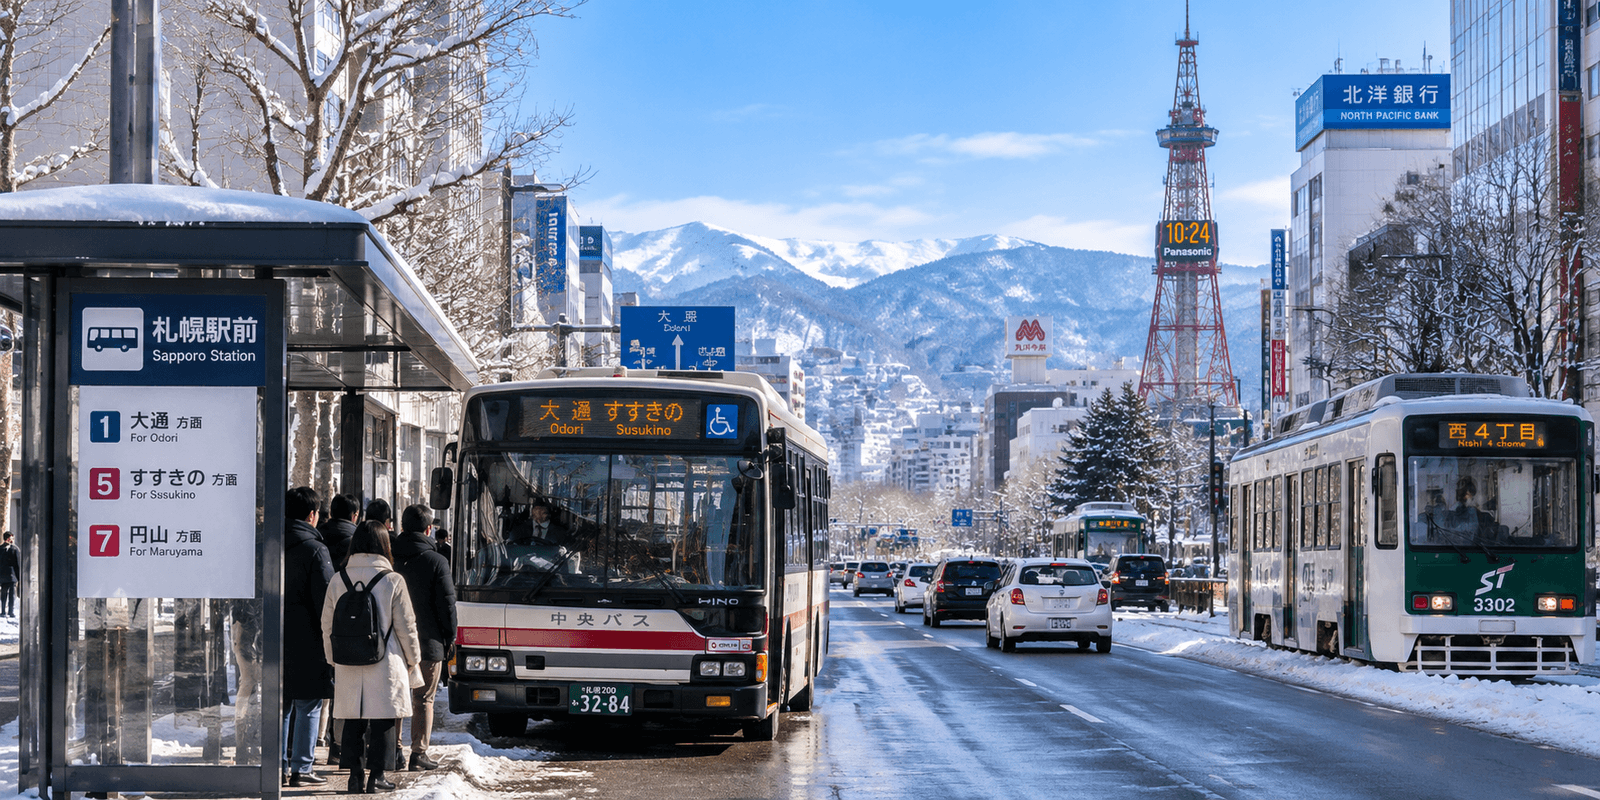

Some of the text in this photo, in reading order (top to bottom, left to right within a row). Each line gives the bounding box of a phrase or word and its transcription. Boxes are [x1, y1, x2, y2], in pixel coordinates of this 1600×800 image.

[1342, 85, 1439, 104] 北洋銀行
[1340, 111, 1440, 120] NORTH PACIFIC BANK
[1165, 221, 1211, 244] 10:24
[1163, 247, 1212, 256] Panasonic
[152, 316, 258, 343] 札幌駅前
[152, 349, 256, 364] Sapporo Station
[539, 399, 684, 422] 大通 すすきの
[100, 415, 109, 438] 1
[130, 411, 169, 430] 大通
[550, 423, 672, 436] Odori Susukino
[130, 433, 178, 443] For Odori
[1496, 439, 1527, 448] chome
[97, 473, 113, 496] 5
[130, 469, 206, 487] すすきの
[130, 489, 147, 500] For
[96, 530, 113, 552] 7
[130, 525, 169, 544] 円山
[129, 547, 203, 558] For Maruyama
[1475, 563, 1515, 596] ST
[1473, 598, 1515, 612] 3302
[550, 611, 651, 628] 中央バス
[580, 694, 630, 713] 32-84
